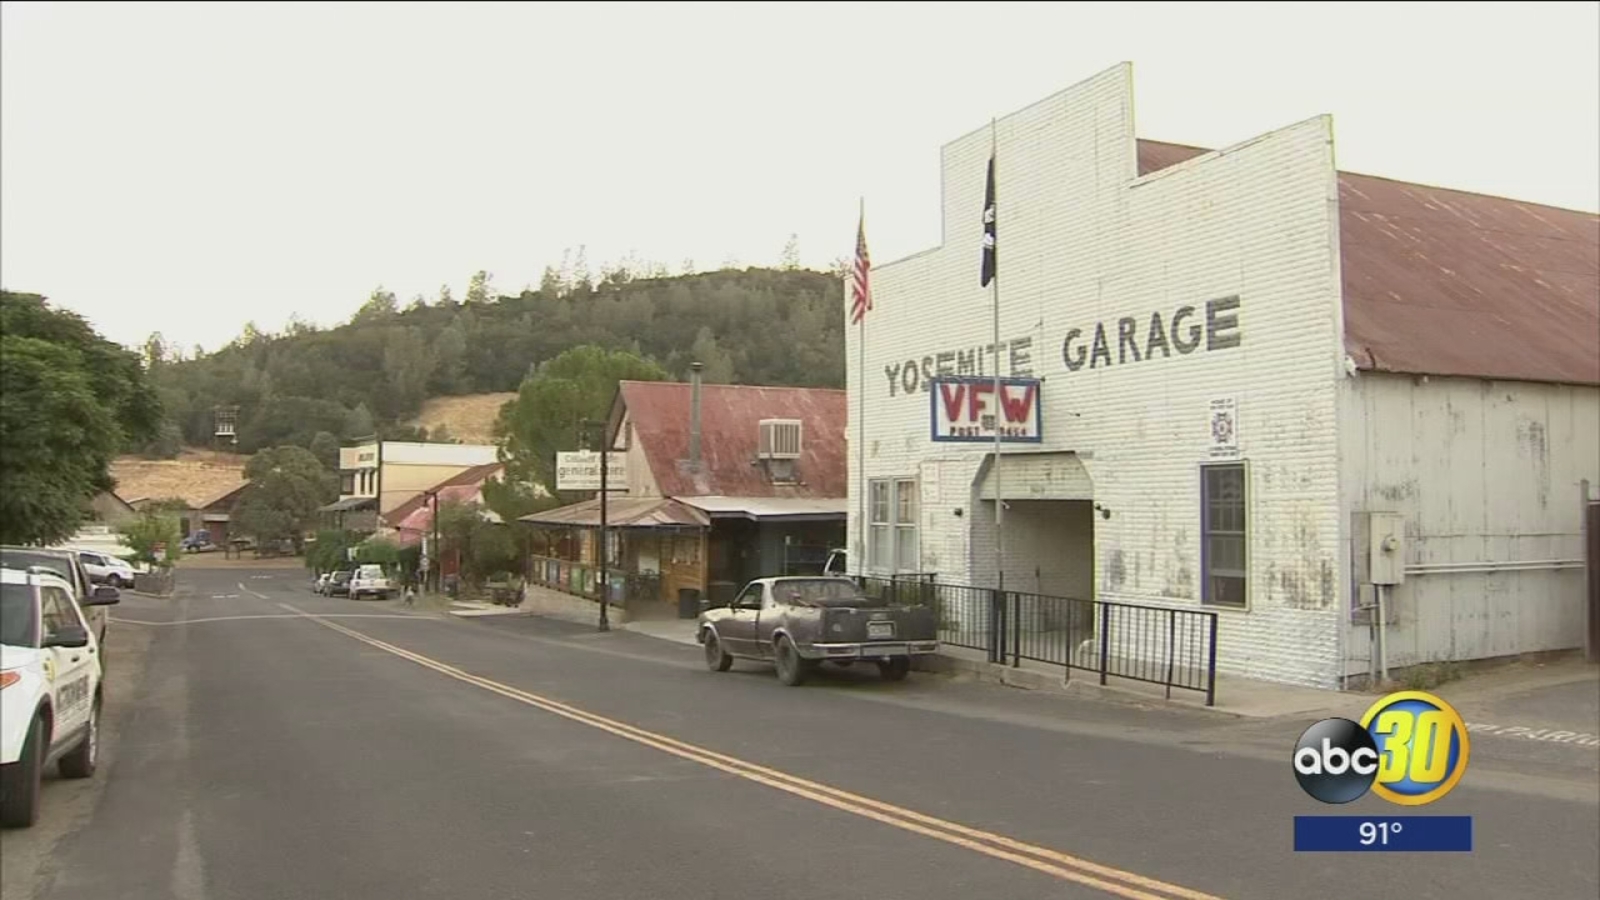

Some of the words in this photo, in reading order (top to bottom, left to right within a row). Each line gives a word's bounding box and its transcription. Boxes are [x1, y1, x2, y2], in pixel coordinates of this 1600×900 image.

[885, 336, 1033, 397] YOSEMITE
[1062, 294, 1241, 371] GARAGE
[940, 383, 1035, 423] VFW
[949, 426, 980, 437] POST
